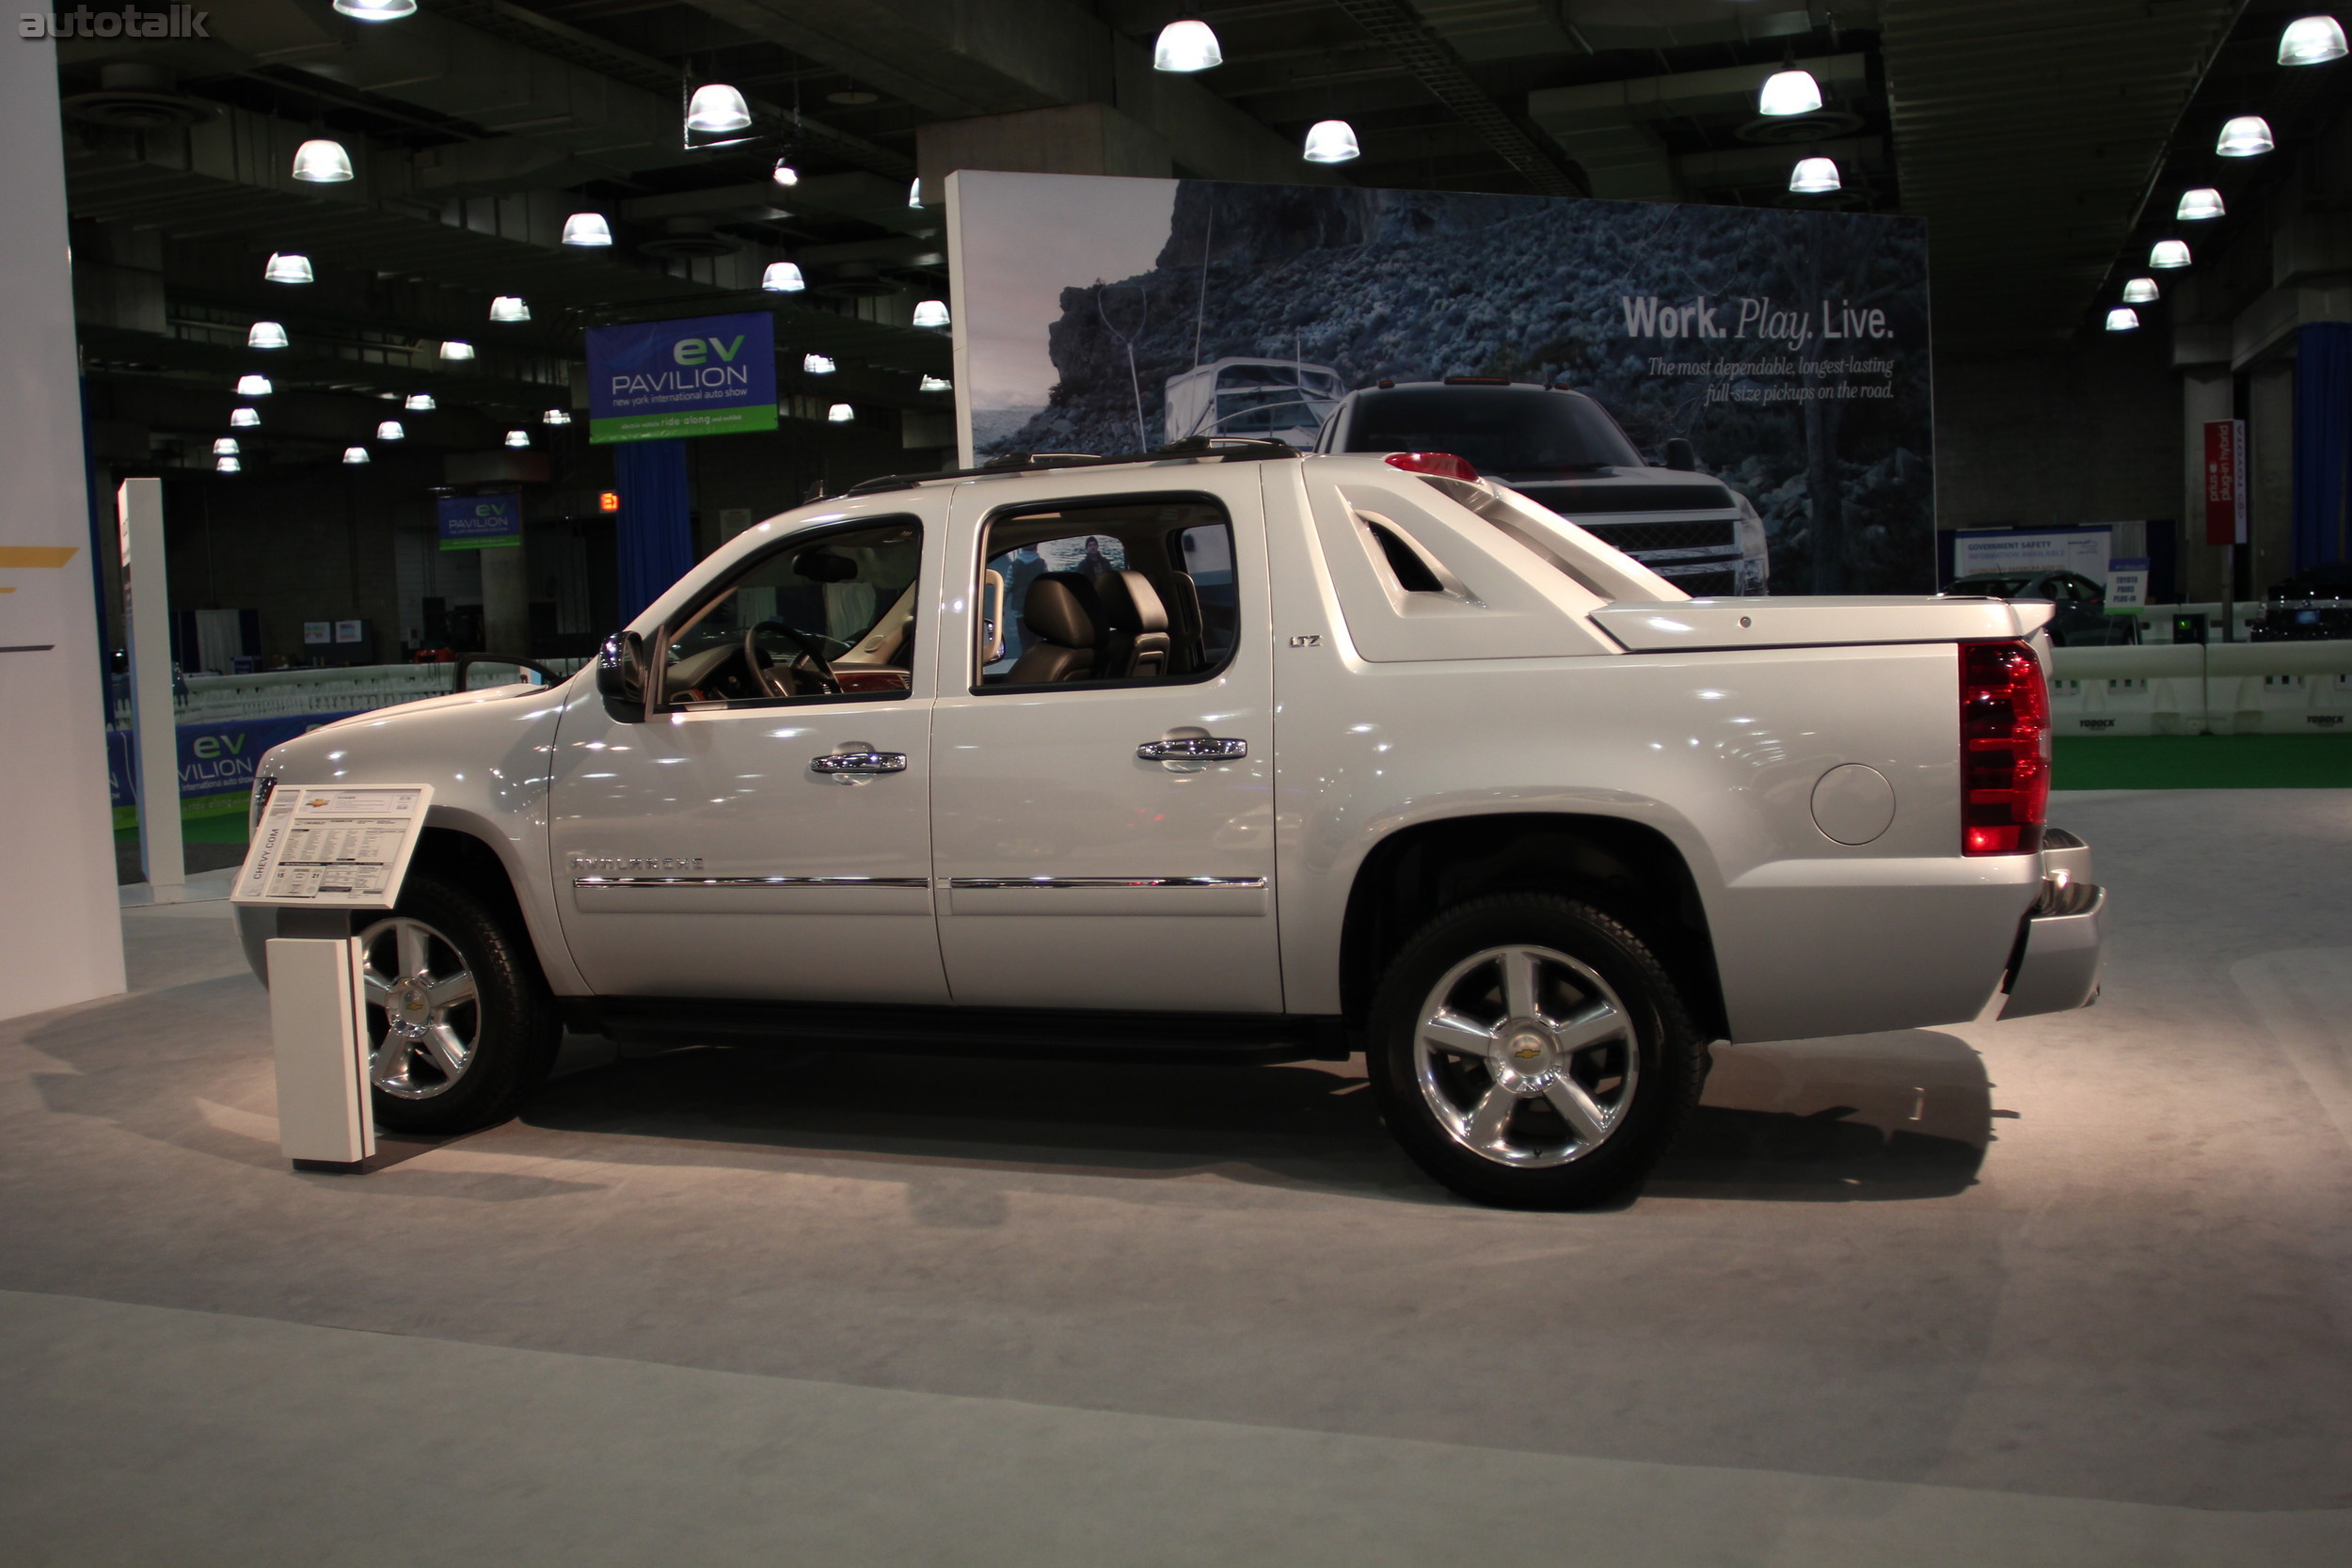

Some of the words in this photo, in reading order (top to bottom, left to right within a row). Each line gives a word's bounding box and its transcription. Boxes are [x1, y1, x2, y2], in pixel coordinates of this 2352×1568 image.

[1622, 295, 1727, 339] Work.
[1734, 296, 1813, 352] Play.
[1823, 299, 1895, 339] Live.
[674, 335, 746, 366] ev
[612, 365, 748, 395] PAVILION
[1648, 356, 1676, 375] The
[1677, 359, 1711, 375] most
[1714, 356, 1796, 380] dependable,
[1799, 355, 1895, 379] longest-lasting
[612, 397, 630, 406] new
[631, 394, 649, 406] york
[651, 389, 703, 404] international
[705, 388, 723, 399] auto
[724, 387, 748, 397] show
[1704, 383, 1761, 406] full-size
[1764, 382, 1815, 406] pickups
[1818, 387, 1835, 399] on
[1837, 380, 1859, 399] the
[1860, 380, 1895, 399] road.
[2219, 425, 2231, 460] hybrid
[2210, 475, 2220, 501] prius
[2221, 463, 2233, 501] plug-in
[448, 516, 508, 530] PAVILION
[475, 503, 508, 517] ev
[1968, 542, 2019, 551] GOVERNMENT
[2021, 540, 2052, 549] SAFETY
[1289, 634, 1323, 648] LTZ
[193, 733, 246, 759] ev
[178, 756, 253, 783] VILION
[182, 778, 222, 791] international
[253, 829, 279, 879] CHEVY.COM
